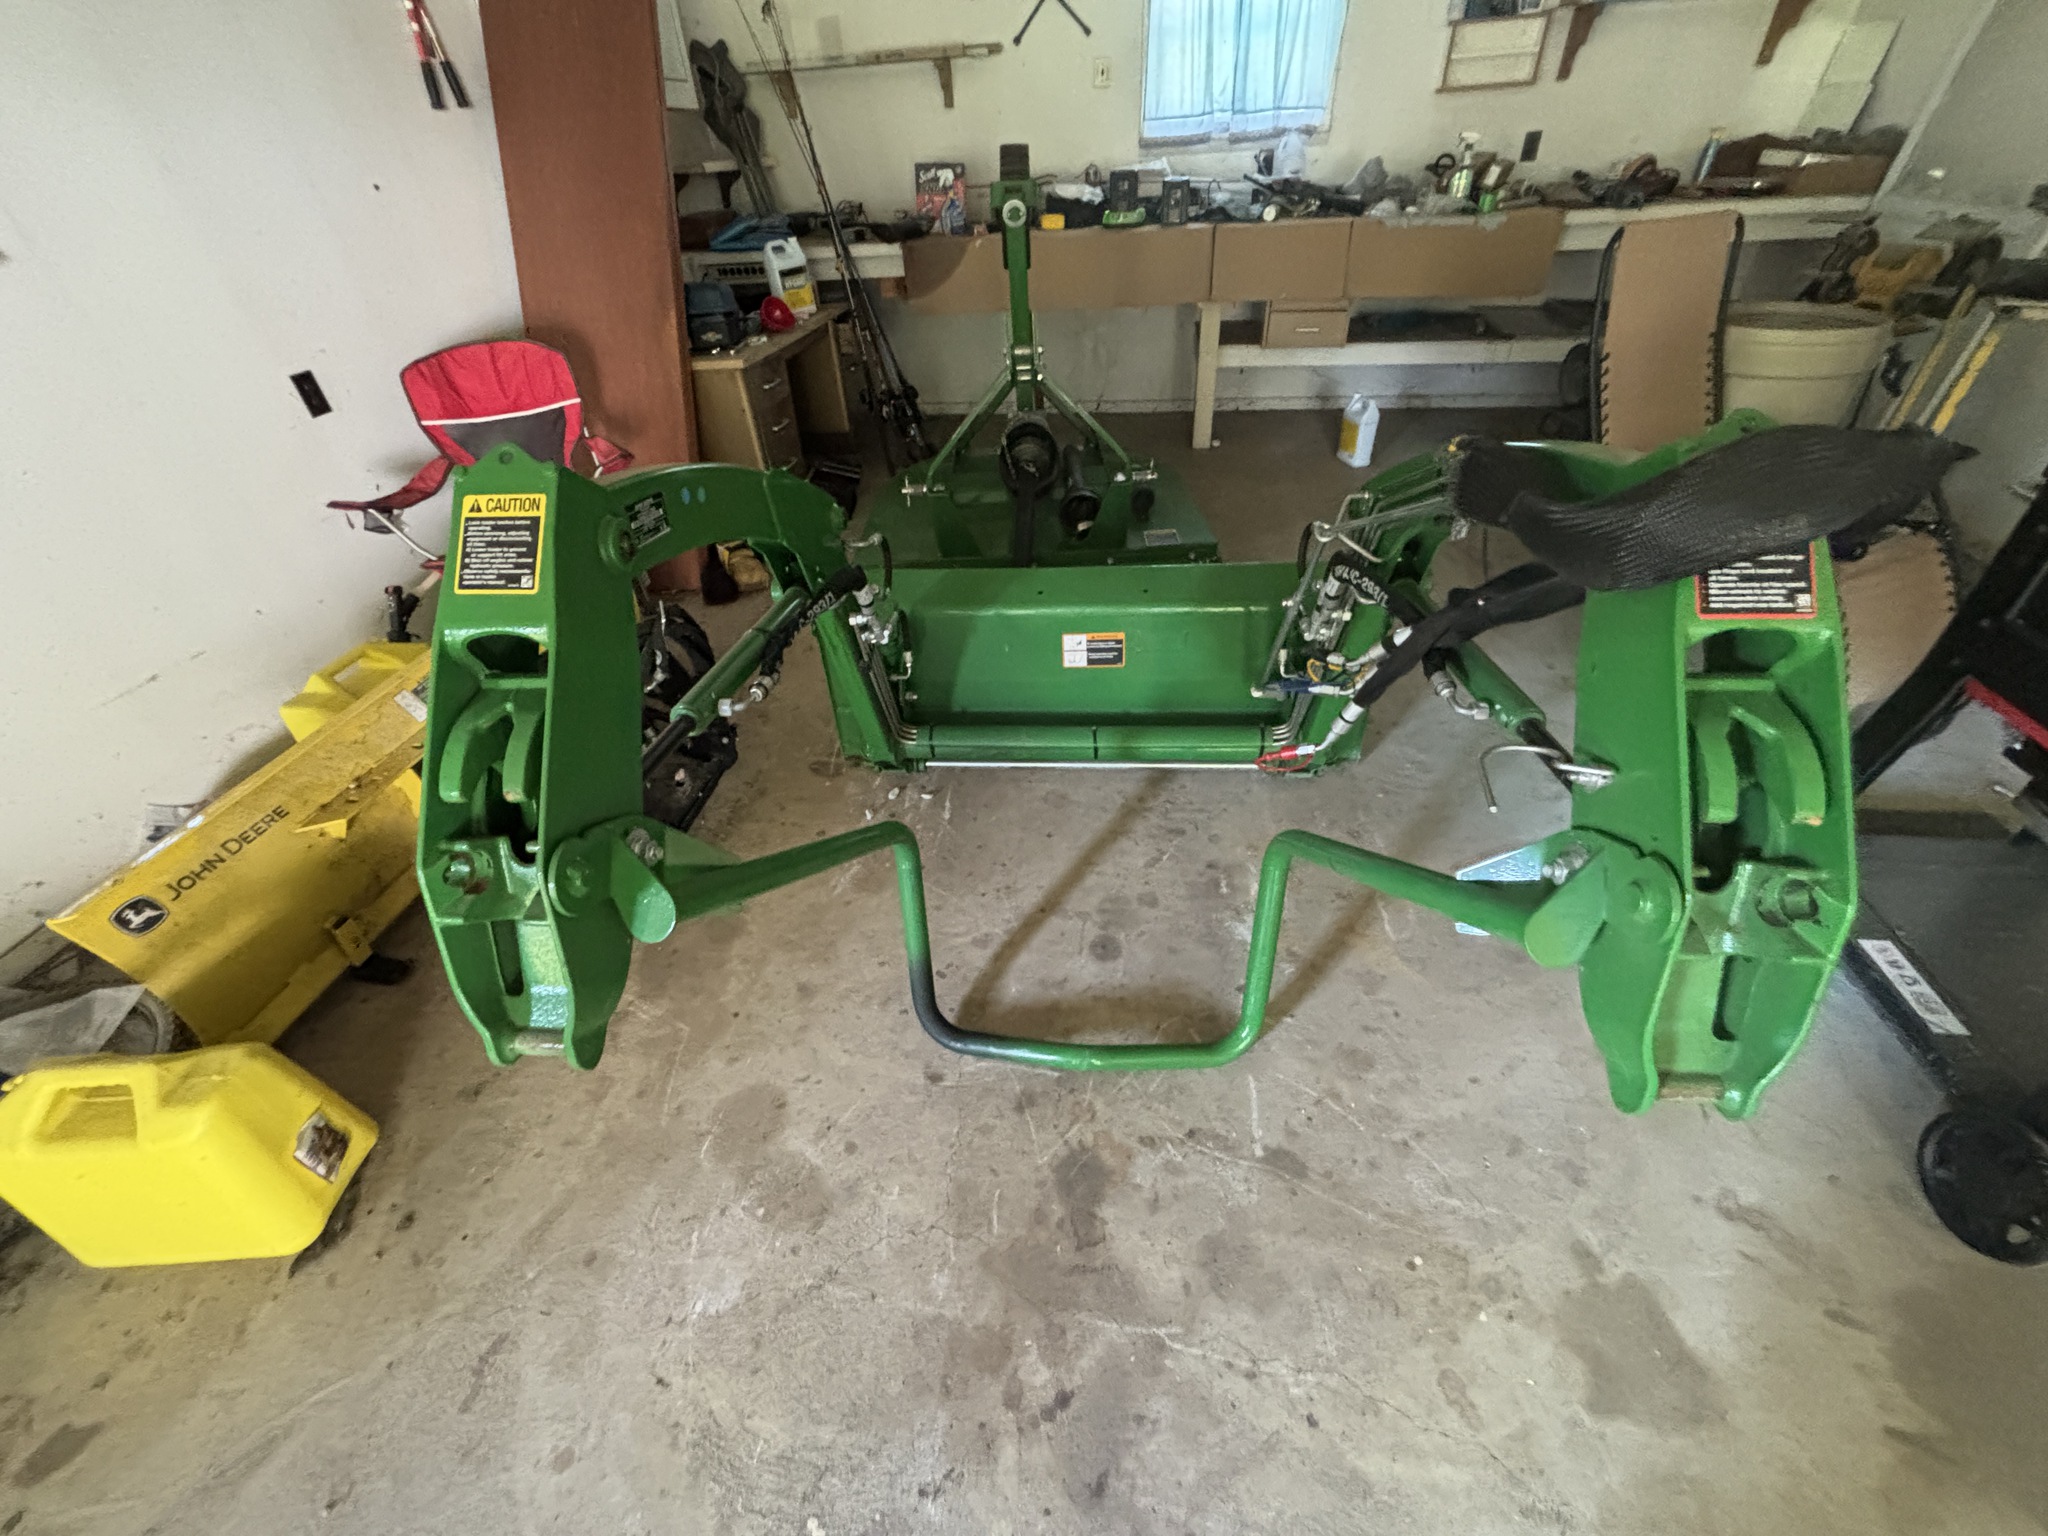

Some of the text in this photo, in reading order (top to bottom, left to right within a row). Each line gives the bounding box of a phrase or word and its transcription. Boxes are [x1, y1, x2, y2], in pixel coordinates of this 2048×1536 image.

[485, 497, 541, 513] CAUTION
[165, 805, 290, 902] JOHN DEERE
